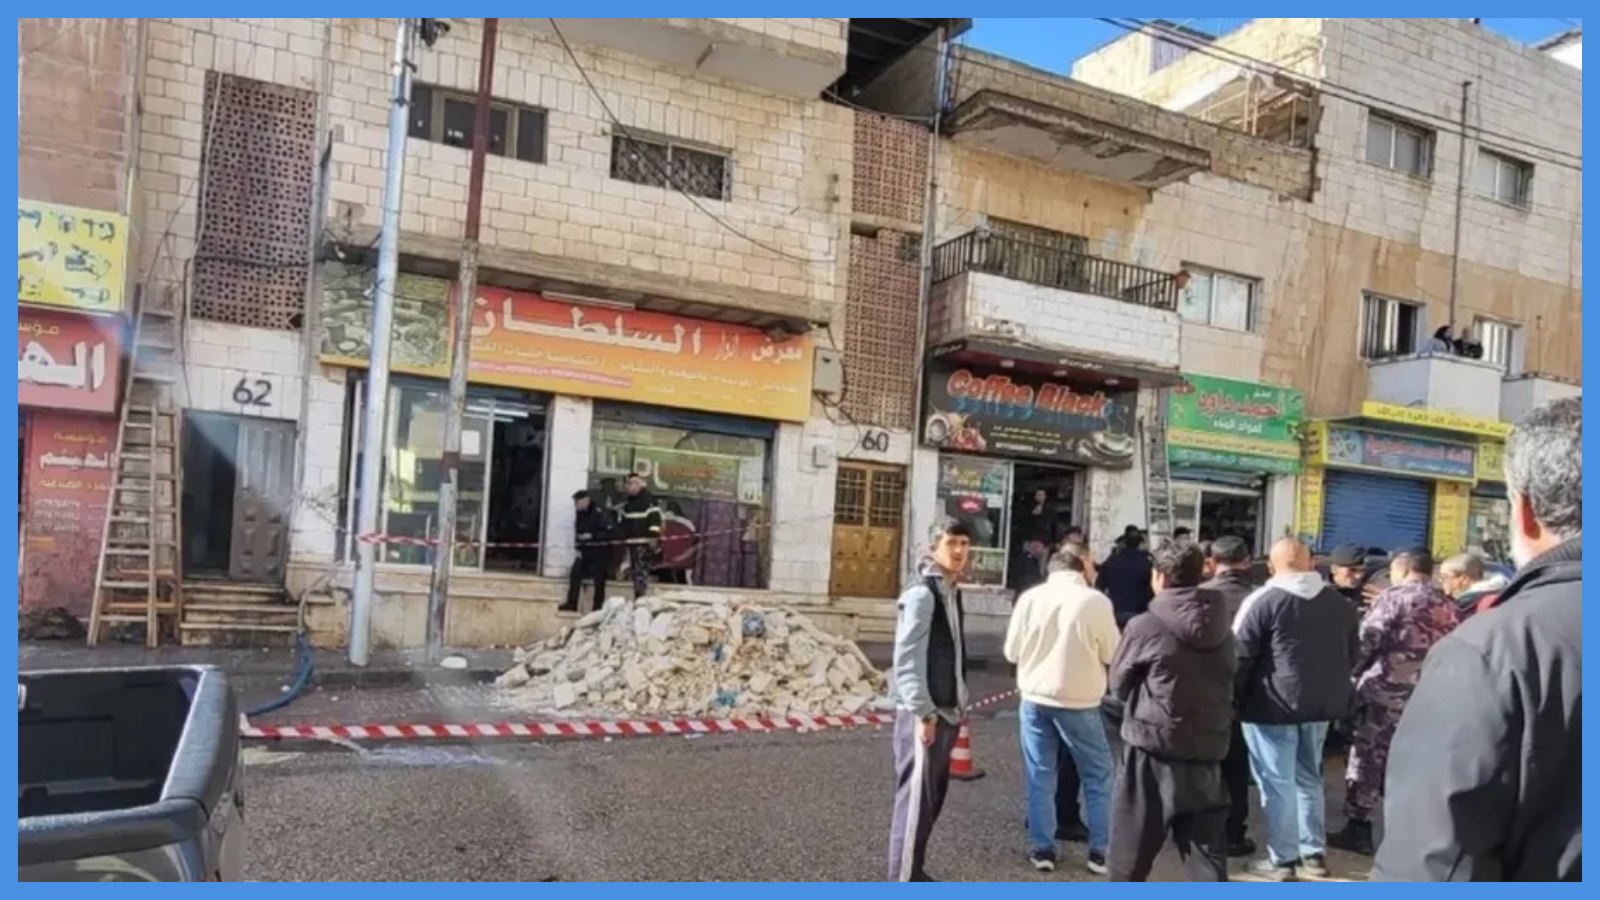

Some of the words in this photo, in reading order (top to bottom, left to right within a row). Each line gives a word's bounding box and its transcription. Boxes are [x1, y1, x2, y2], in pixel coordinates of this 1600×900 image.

[232, 377, 273, 407] 62
[947, 369, 1034, 409] Coffee
[1035, 383, 1107, 419] Black
[861, 429, 890, 452] 60
